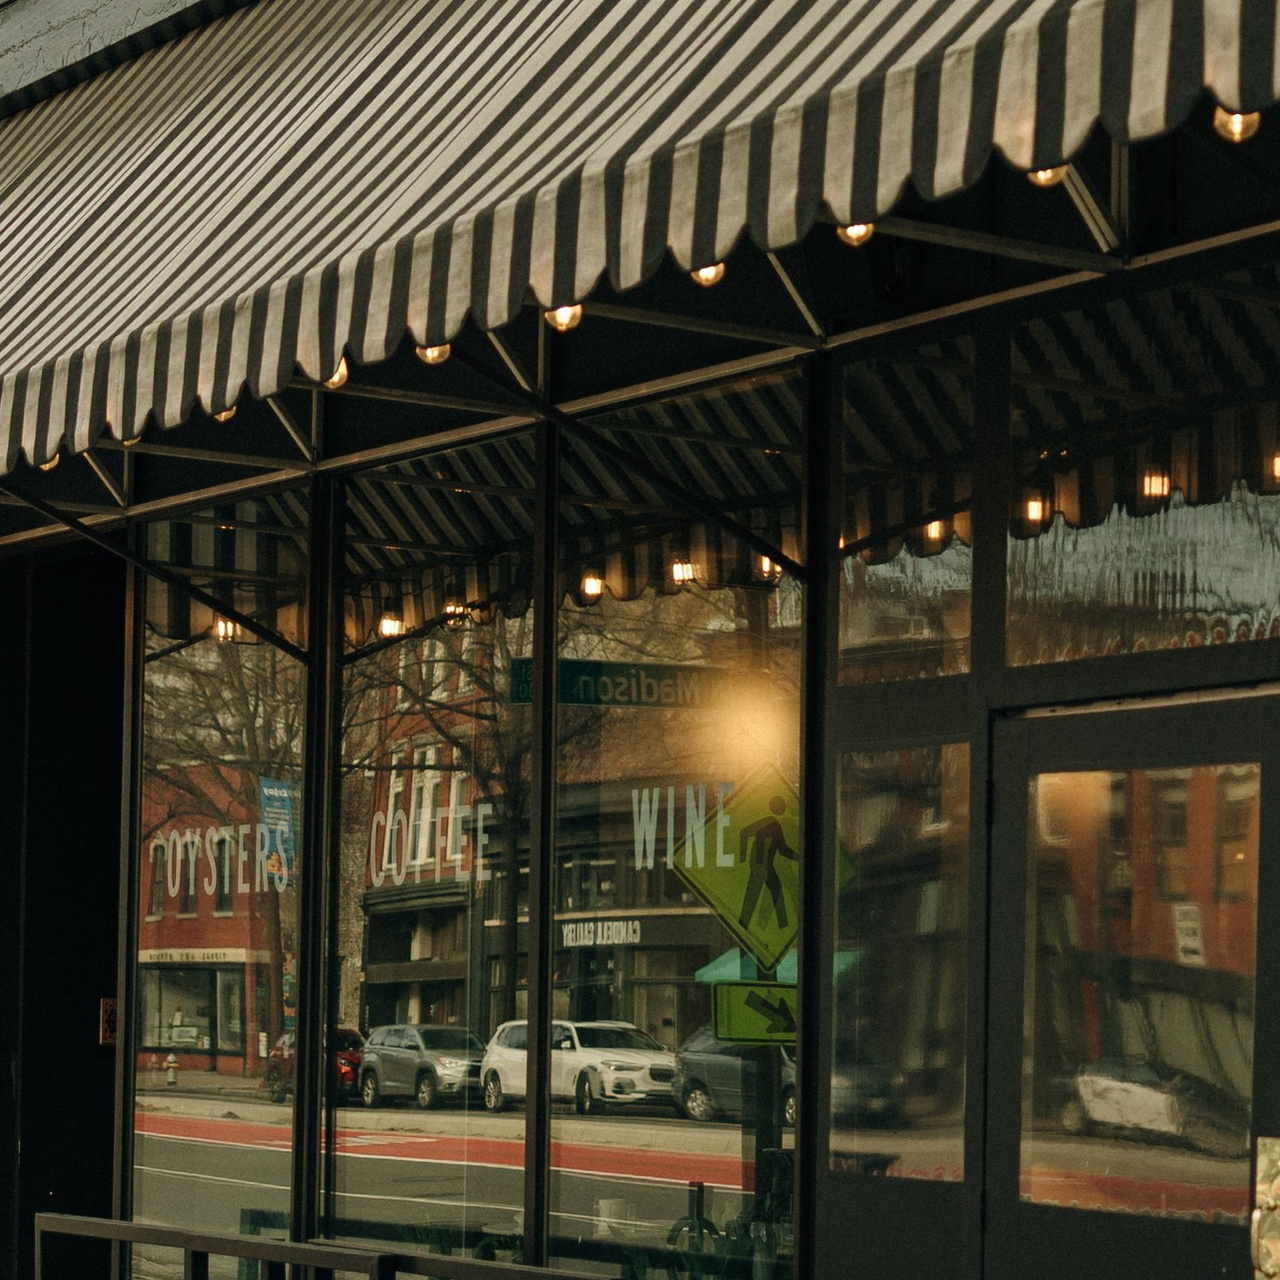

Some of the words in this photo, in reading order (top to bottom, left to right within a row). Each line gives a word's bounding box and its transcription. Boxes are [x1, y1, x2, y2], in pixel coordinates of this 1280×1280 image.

[167, 821, 291, 898] OYSTERS
[371, 803, 493, 888] COFFEE
[632, 781, 736, 870] WINE
